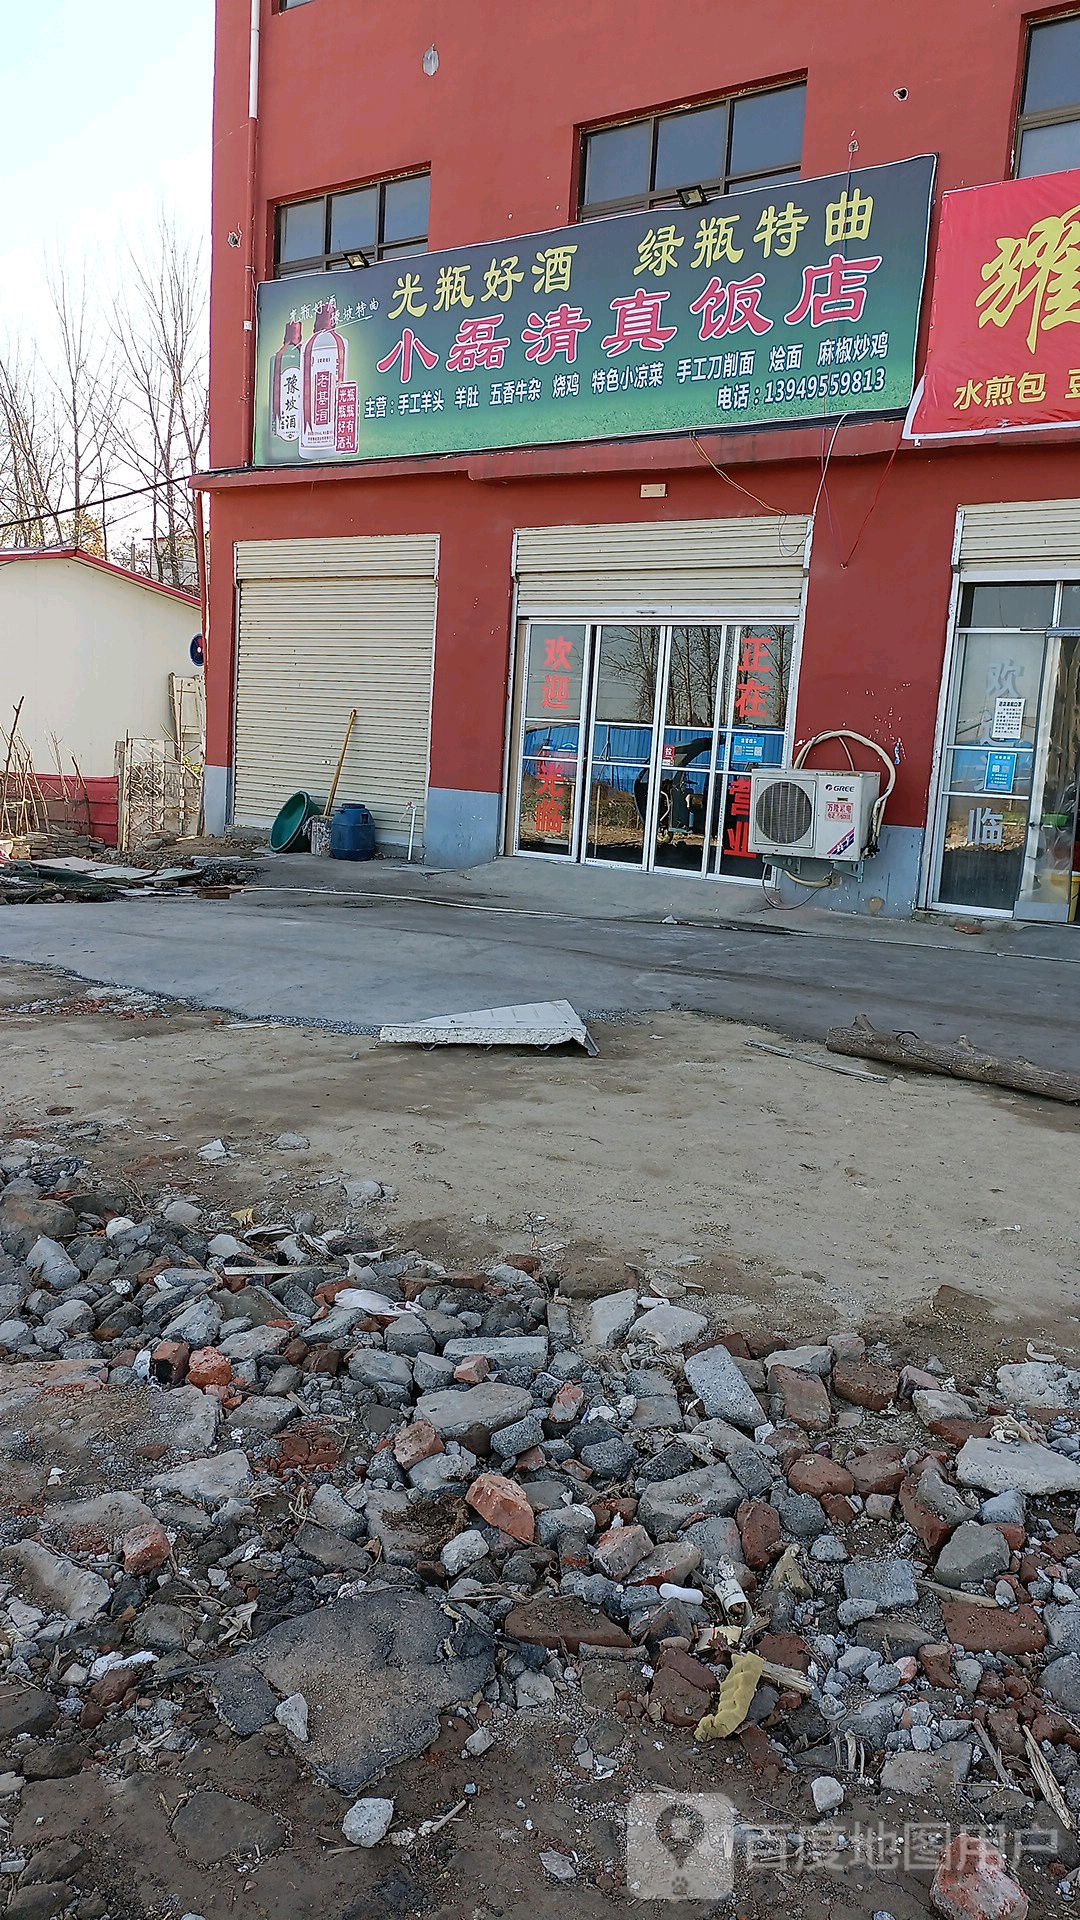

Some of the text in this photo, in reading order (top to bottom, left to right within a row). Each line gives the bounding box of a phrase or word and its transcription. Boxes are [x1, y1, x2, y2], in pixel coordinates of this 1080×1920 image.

[387, 188, 874, 320] 光瓶好酒 绿瓶特曲
[376, 253, 883, 384] 小磊清真饭店
[455, 386, 479, 408] 羊肚
[489, 377, 542, 404] 五香牛杂
[552, 371, 580, 399] 烧鸡
[591, 362, 665, 394] 特色小凉菜
[676, 350, 756, 383] 手工刀削面
[769, 343, 803, 371] 烩面
[816, 331, 889, 367] 麻椒炒鸡
[953, 372, 1046, 410] 水煎包
[542, 636, 573, 710] 欢迎
[735, 637, 773, 718] 正在
[833, 784, 855, 793] GREE
[967, 807, 1003, 846] 临
